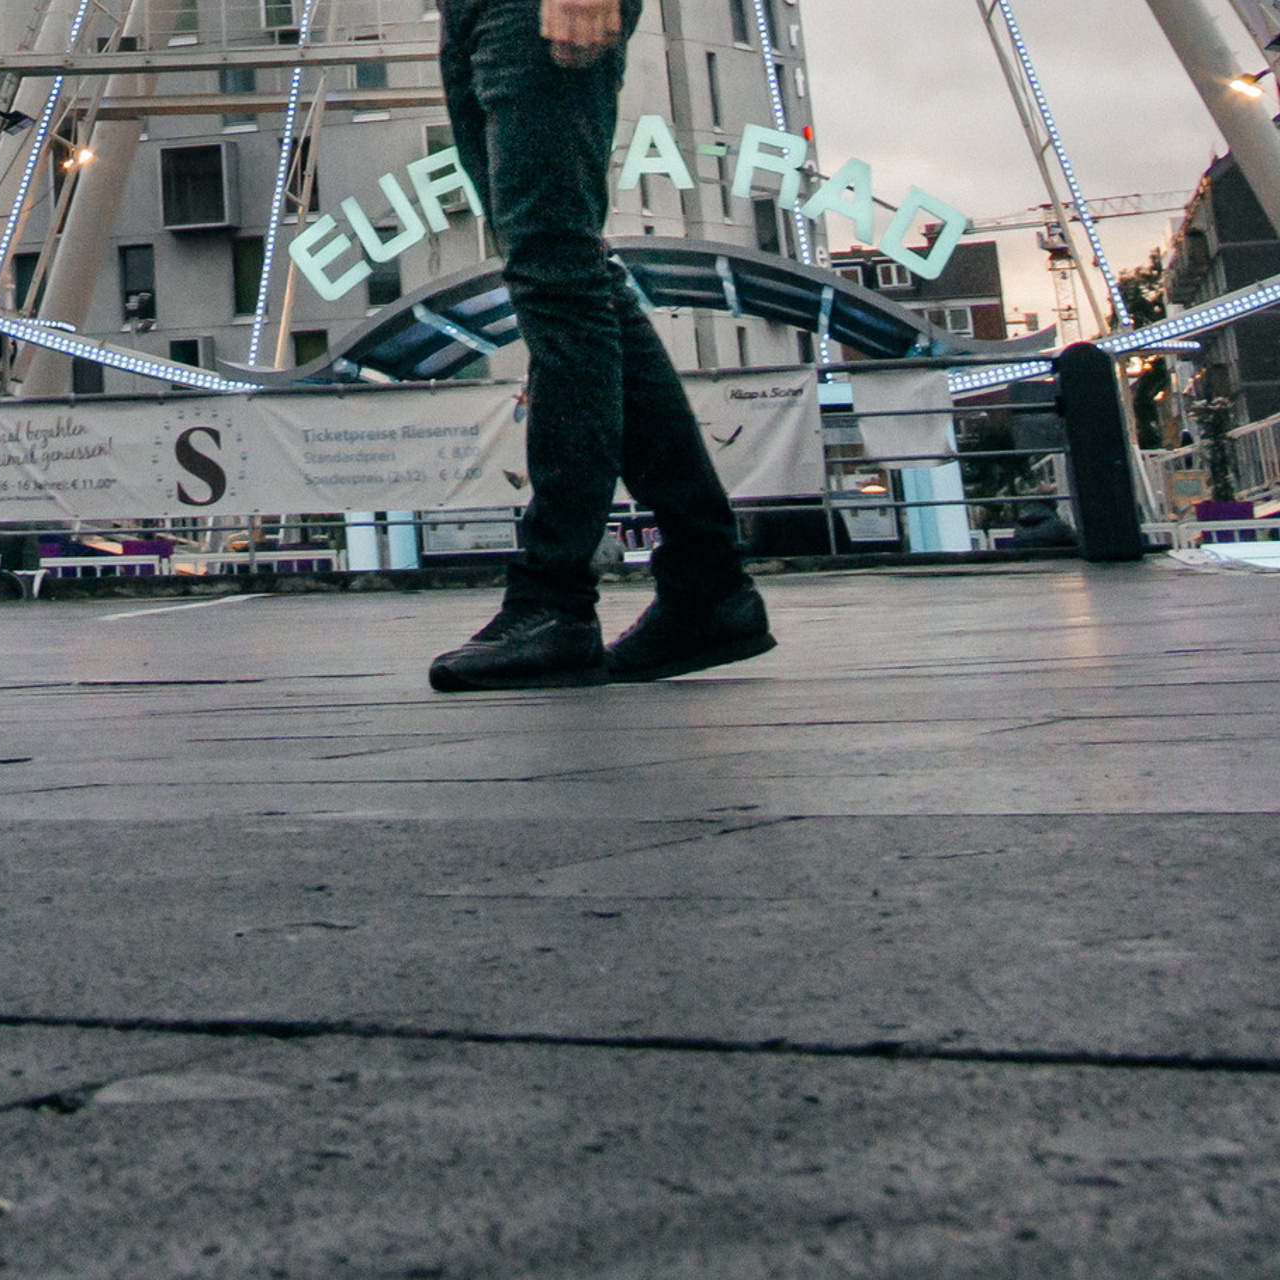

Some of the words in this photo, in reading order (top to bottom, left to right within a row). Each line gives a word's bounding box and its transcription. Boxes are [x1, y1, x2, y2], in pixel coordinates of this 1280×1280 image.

[303, 427, 397, 444] Ticketpreise
[401, 423, 480, 440] Riesenrad
[175, 425, 227, 507] S
